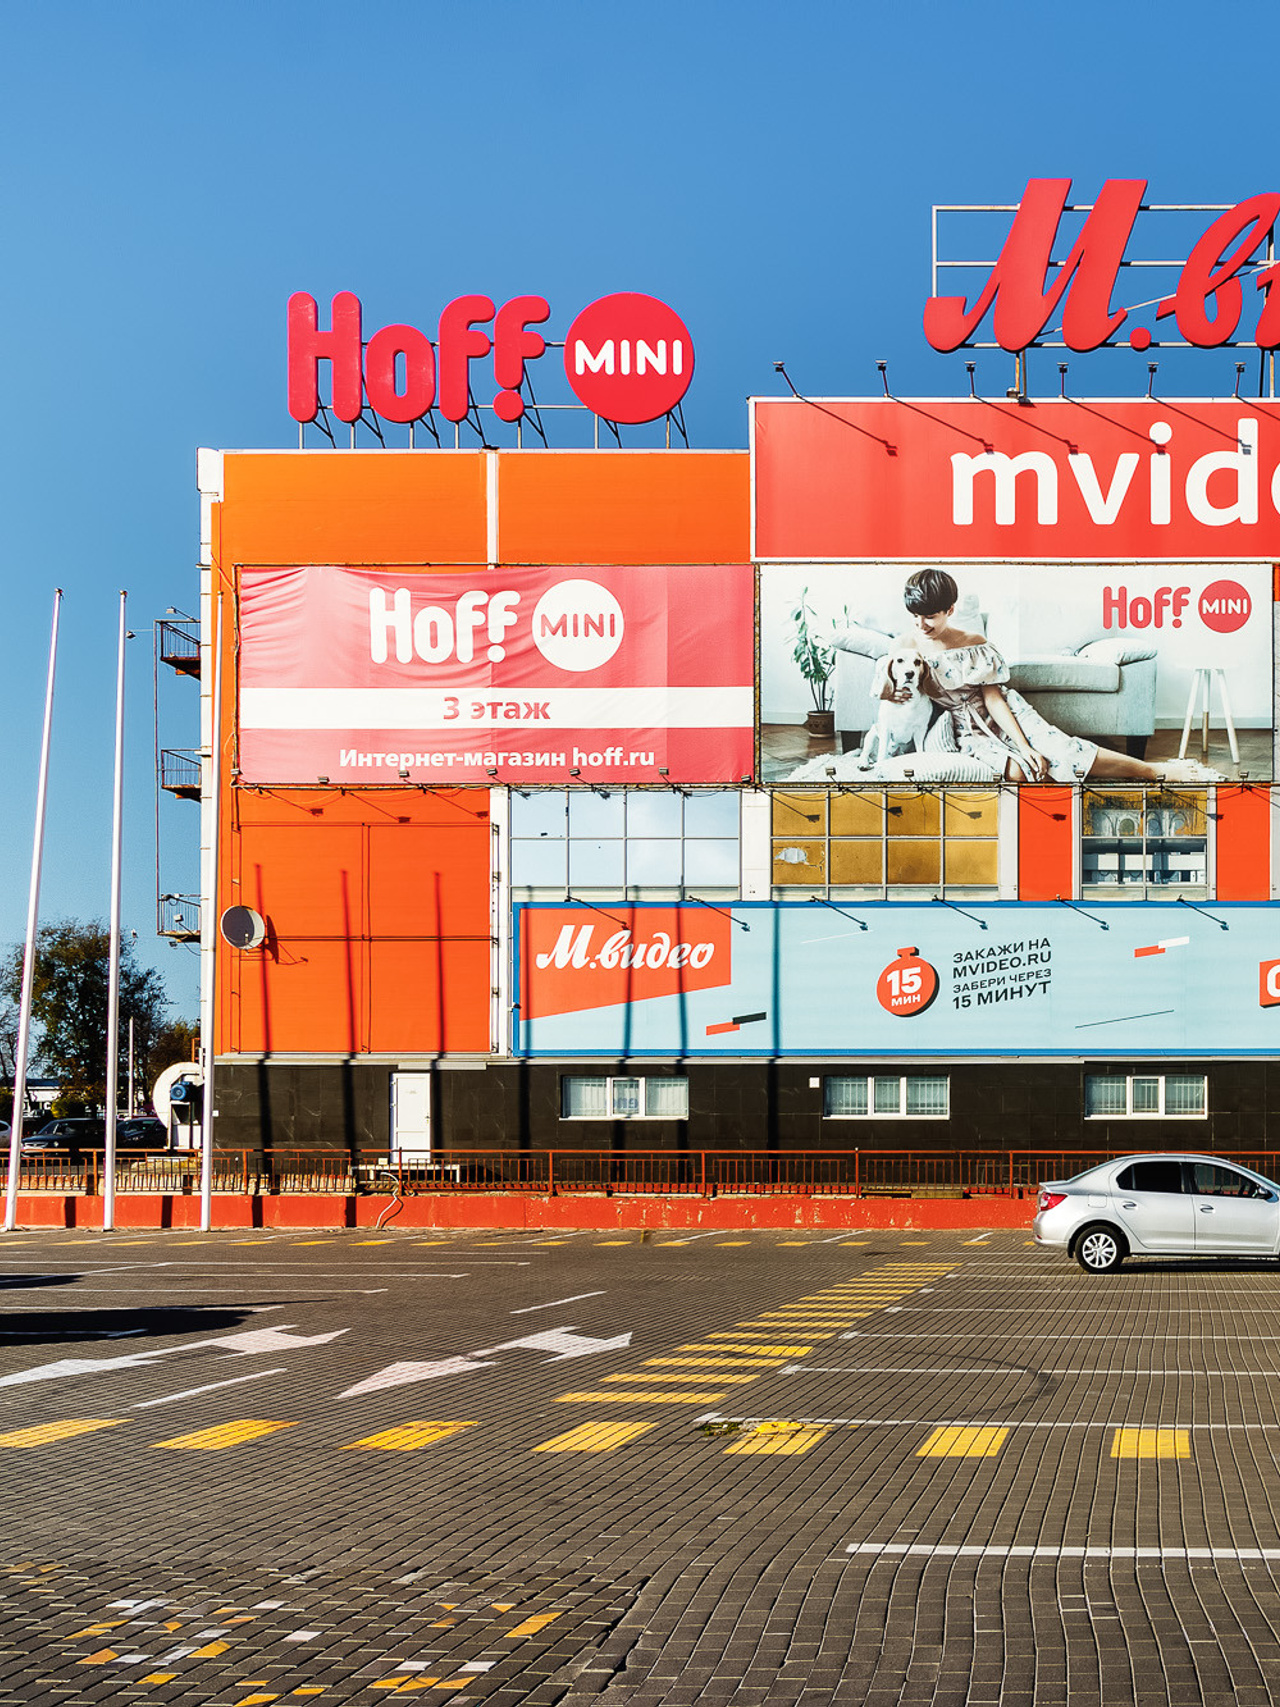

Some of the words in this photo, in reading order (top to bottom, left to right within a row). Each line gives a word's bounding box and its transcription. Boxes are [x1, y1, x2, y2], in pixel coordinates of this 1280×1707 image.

[287, 290, 551, 423] Hoff
[574, 339, 684, 376] MINI
[1102, 585, 1192, 630] Hoff
[1201, 598, 1249, 615] MINI
[368, 586, 522, 665] Hoff
[539, 612, 618, 639] MINI
[442, 696, 461, 721] 3
[470, 700, 552, 721] этаж
[338, 748, 567, 771] Интернет-магазин
[571, 746, 656, 768] hoff.ru
[952, 941, 1025, 964] ЗАКАЖИ
[1028, 937, 1052, 950] НА
[952, 950, 1053, 980] MVIDEO.RU
[885, 966, 923, 997] 15
[952, 976, 1007, 994] ЗАБЕРИ
[1008, 968, 1053, 984] ЧЕРЕЗ
[952, 994, 973, 1010] 15
[976, 980, 1053, 1007] МИНУТ
[890, 994, 922, 1007] МИН
